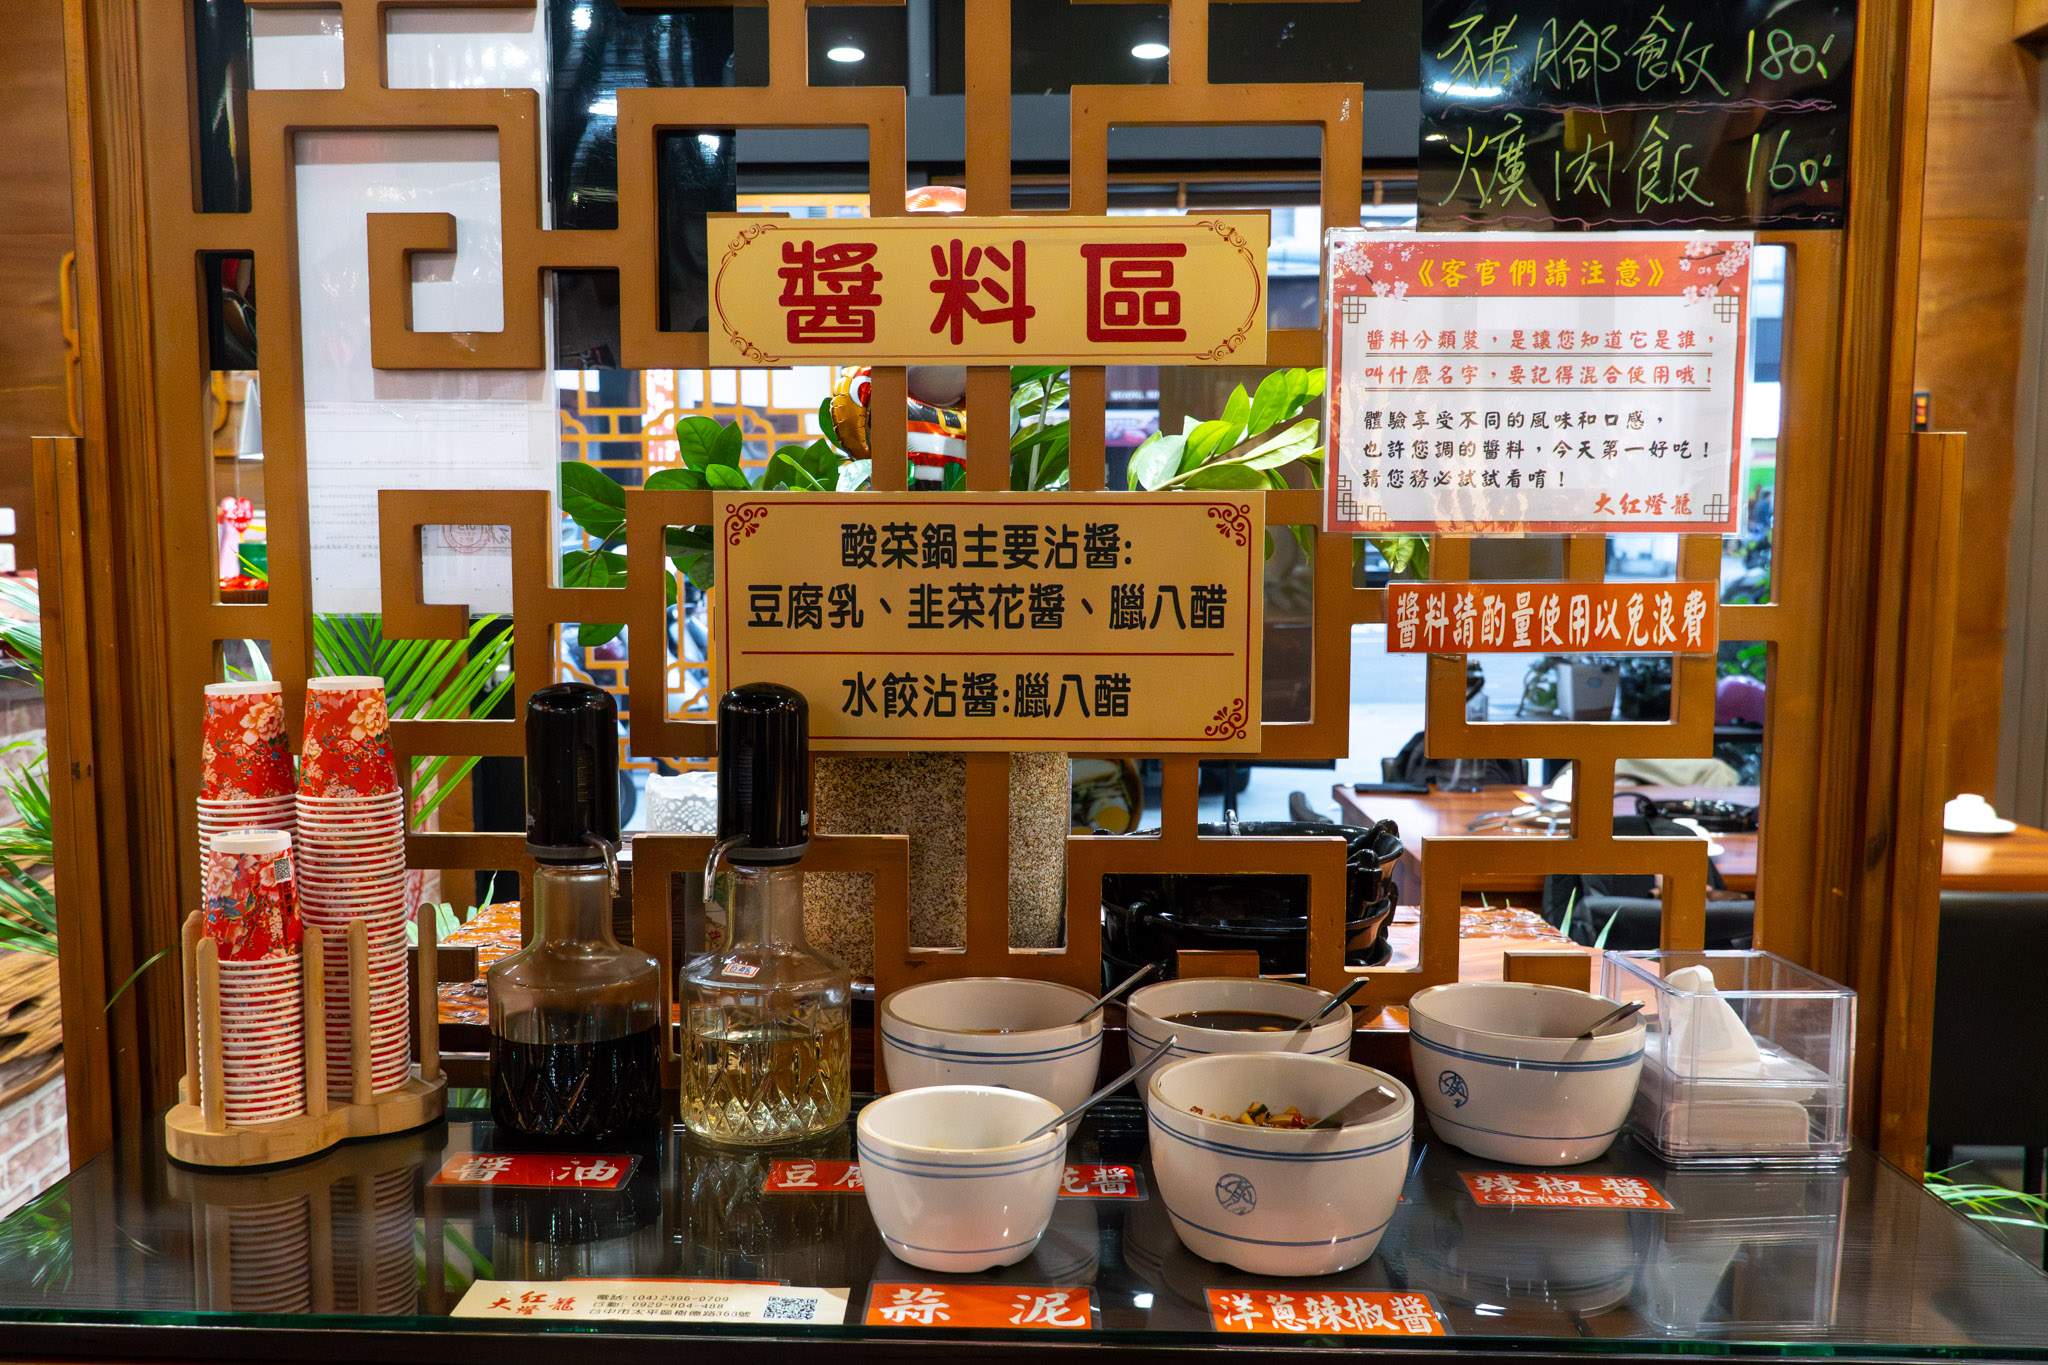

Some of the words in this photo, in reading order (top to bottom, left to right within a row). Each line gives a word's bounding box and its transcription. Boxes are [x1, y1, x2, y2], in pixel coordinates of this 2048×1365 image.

[778, 239, 1187, 345] 醬料區
[1418, 256, 1666, 288] 《客官們請注意》
[840, 521, 1133, 570] 酸菜鍋主要沾醬:
[1396, 588, 1708, 650] 醬料請酌量使用以免浪費
[1475, 1174, 1652, 1199] 辣椒醬
